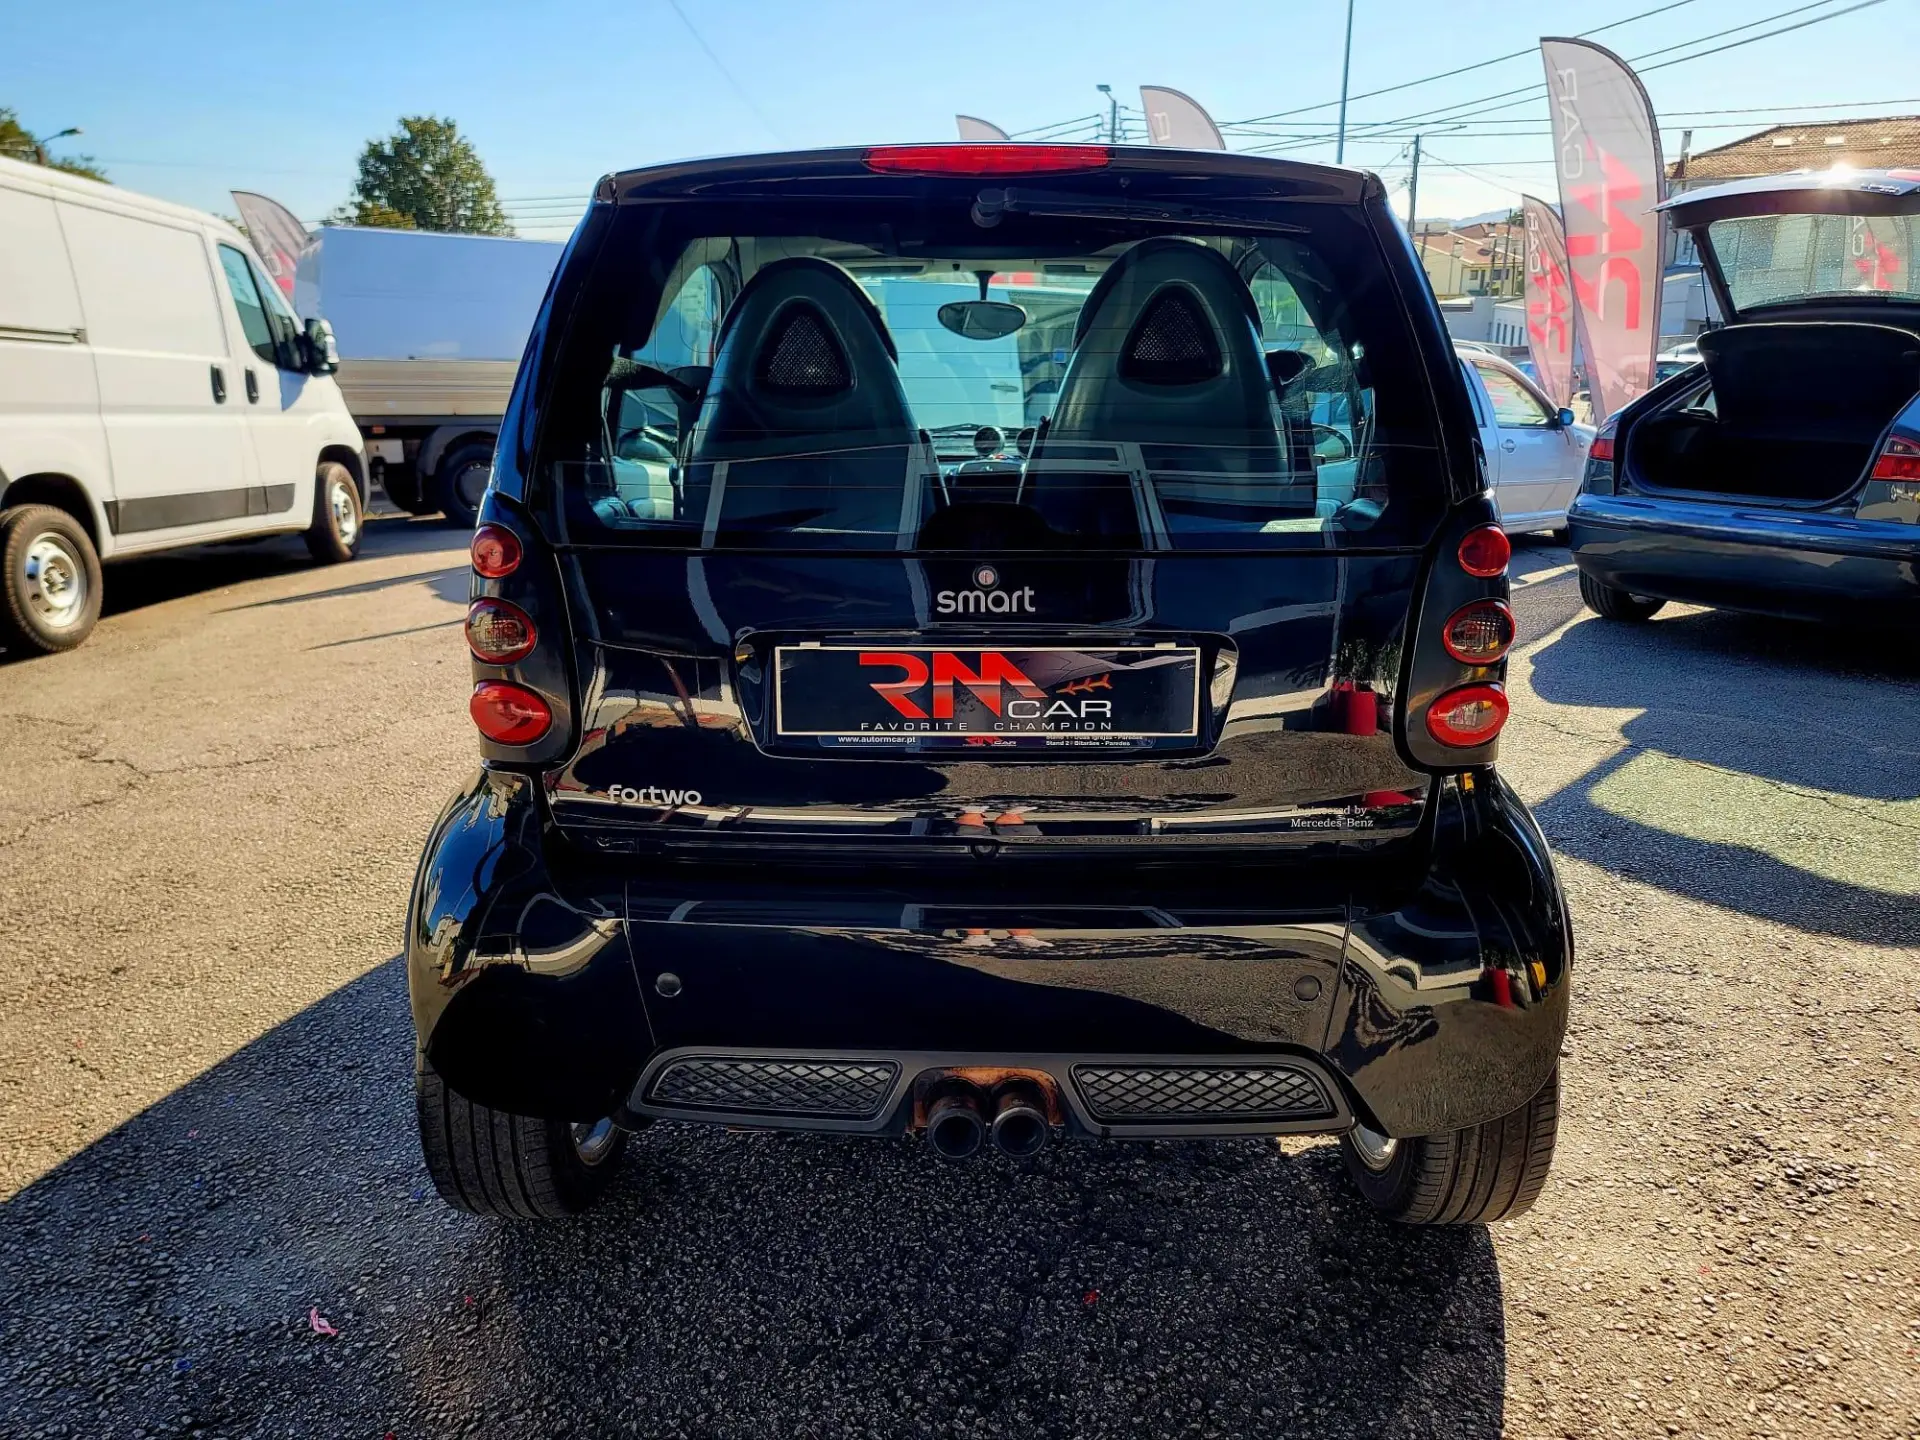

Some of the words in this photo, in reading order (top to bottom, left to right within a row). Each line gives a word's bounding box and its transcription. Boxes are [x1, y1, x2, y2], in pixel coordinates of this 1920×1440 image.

[936, 586, 1036, 613] smart
[1007, 700, 1112, 718] CAR
[860, 722, 969, 731] FAVORITE
[994, 722, 1112, 731] CHAMPION
[838, 735, 916, 744] www.autormcar.pt
[607, 784, 702, 806] fortwo
[1354, 805, 1368, 816] by
[1291, 818, 1374, 828] Mercedes-Benz
